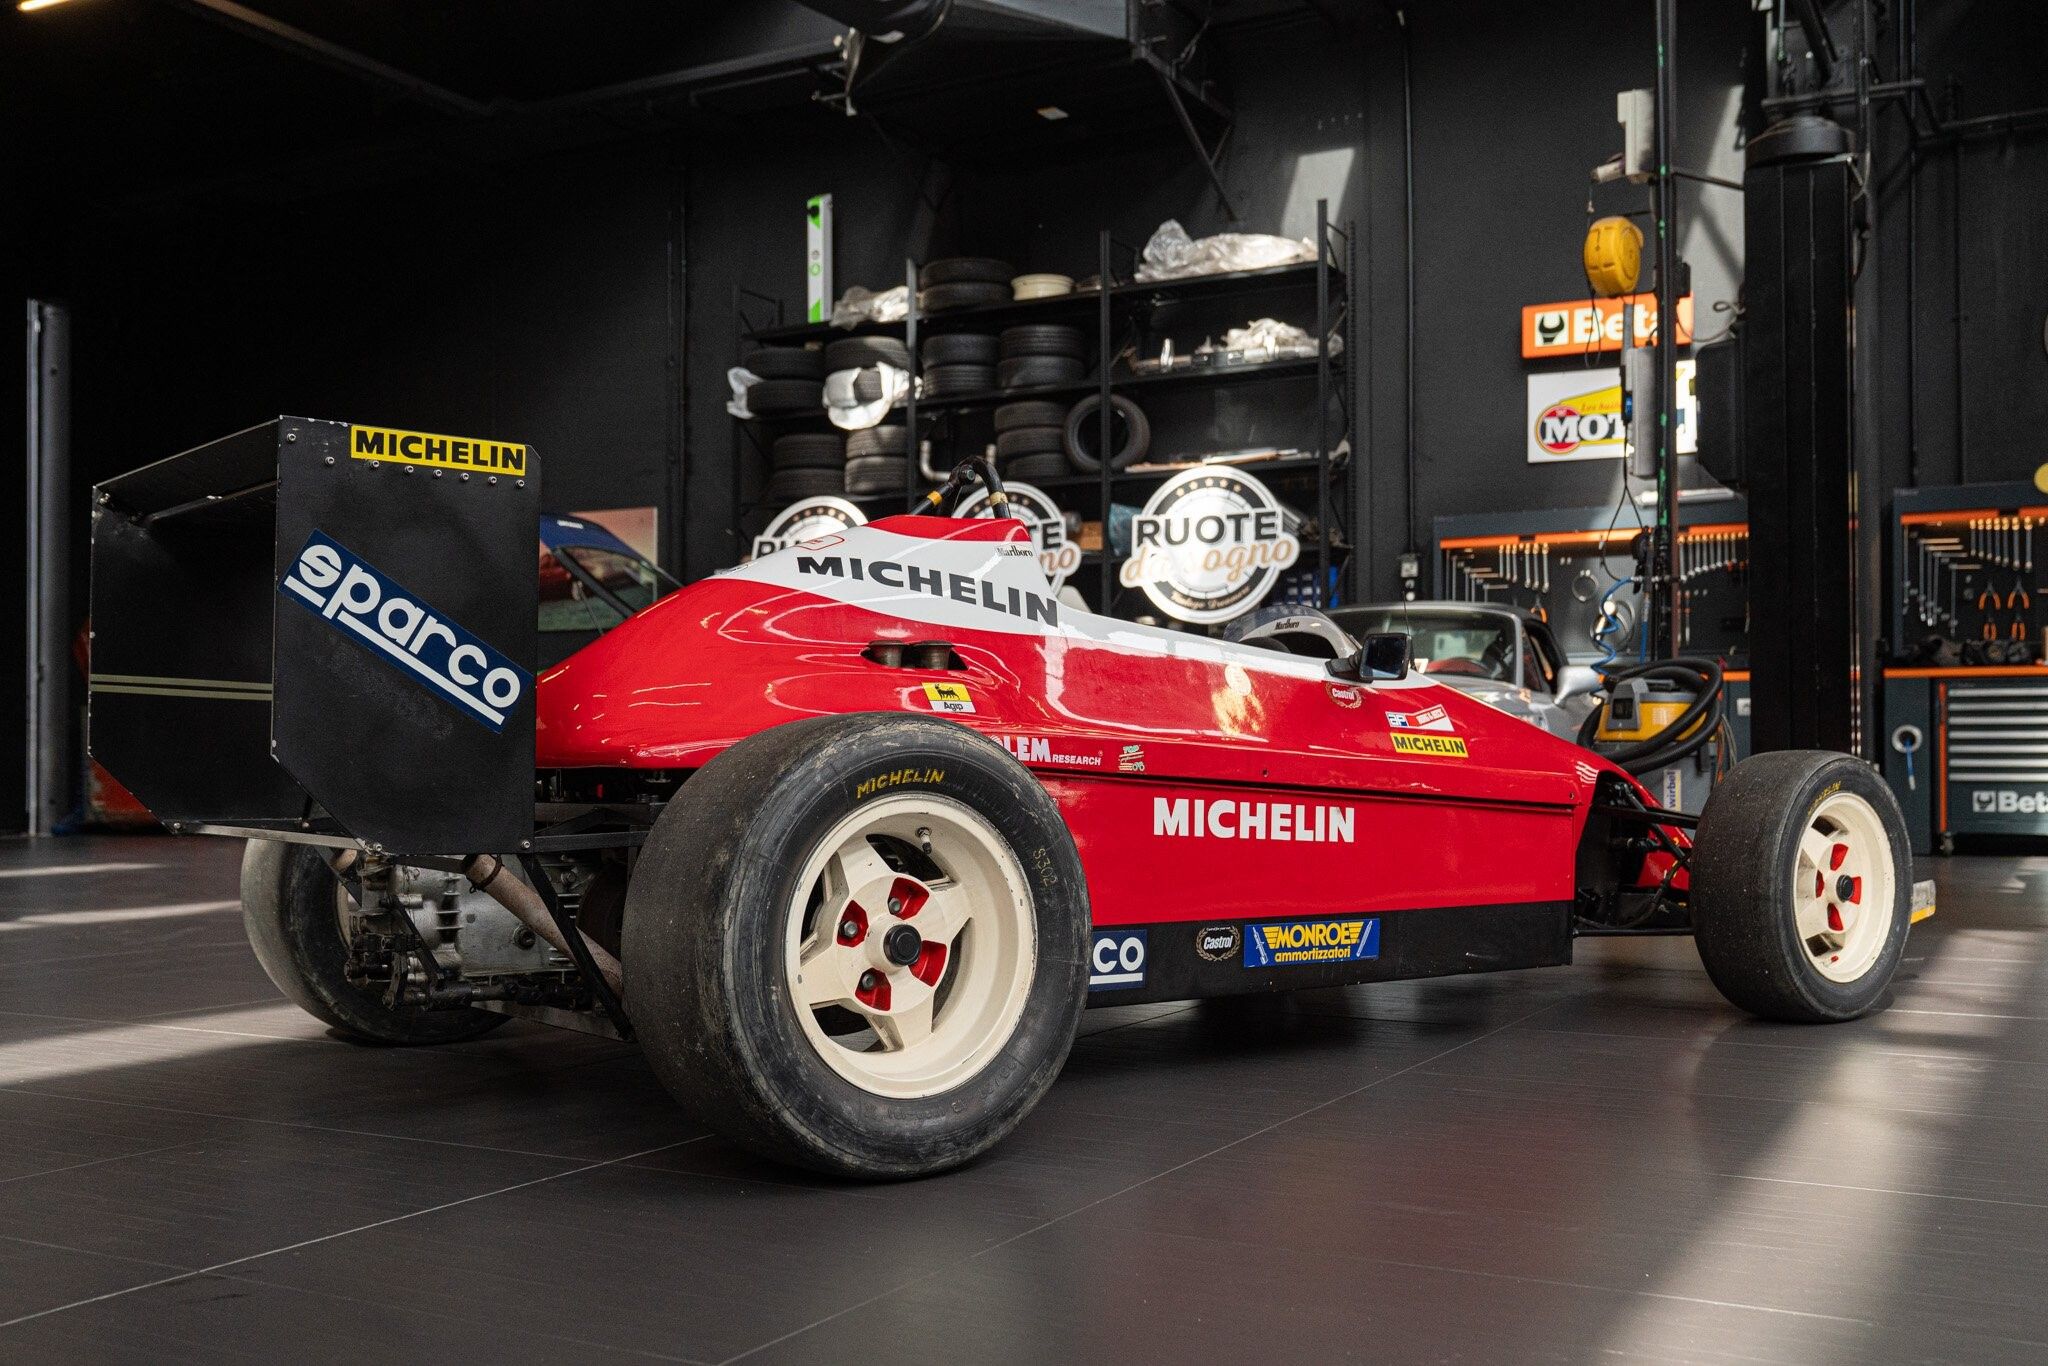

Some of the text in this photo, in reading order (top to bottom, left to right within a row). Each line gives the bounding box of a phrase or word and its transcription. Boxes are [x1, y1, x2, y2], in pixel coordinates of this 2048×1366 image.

[355, 429, 524, 471] MICHELIN
[1136, 511, 1278, 547] RUOTE
[996, 544, 1033, 557] Marlboro
[796, 556, 1059, 628] MICHELIN
[298, 543, 521, 708] sparco
[1274, 618, 1300, 630] Marlboro
[1331, 688, 1355, 701] Castrol
[943, 701, 964, 712] Agip
[1393, 736, 1466, 754] MICHELIN
[1052, 754, 1102, 766] RESEARCH
[857, 768, 945, 799] MICHELIN
[1666, 771, 1676, 808] wirbel
[1998, 790, 2048, 813] Bet
[1153, 797, 1355, 842] MICHELIN
[1203, 935, 1233, 950] Castrol
[1274, 921, 1351, 950] MONROE
[1274, 946, 1351, 962] ammortizzatori
